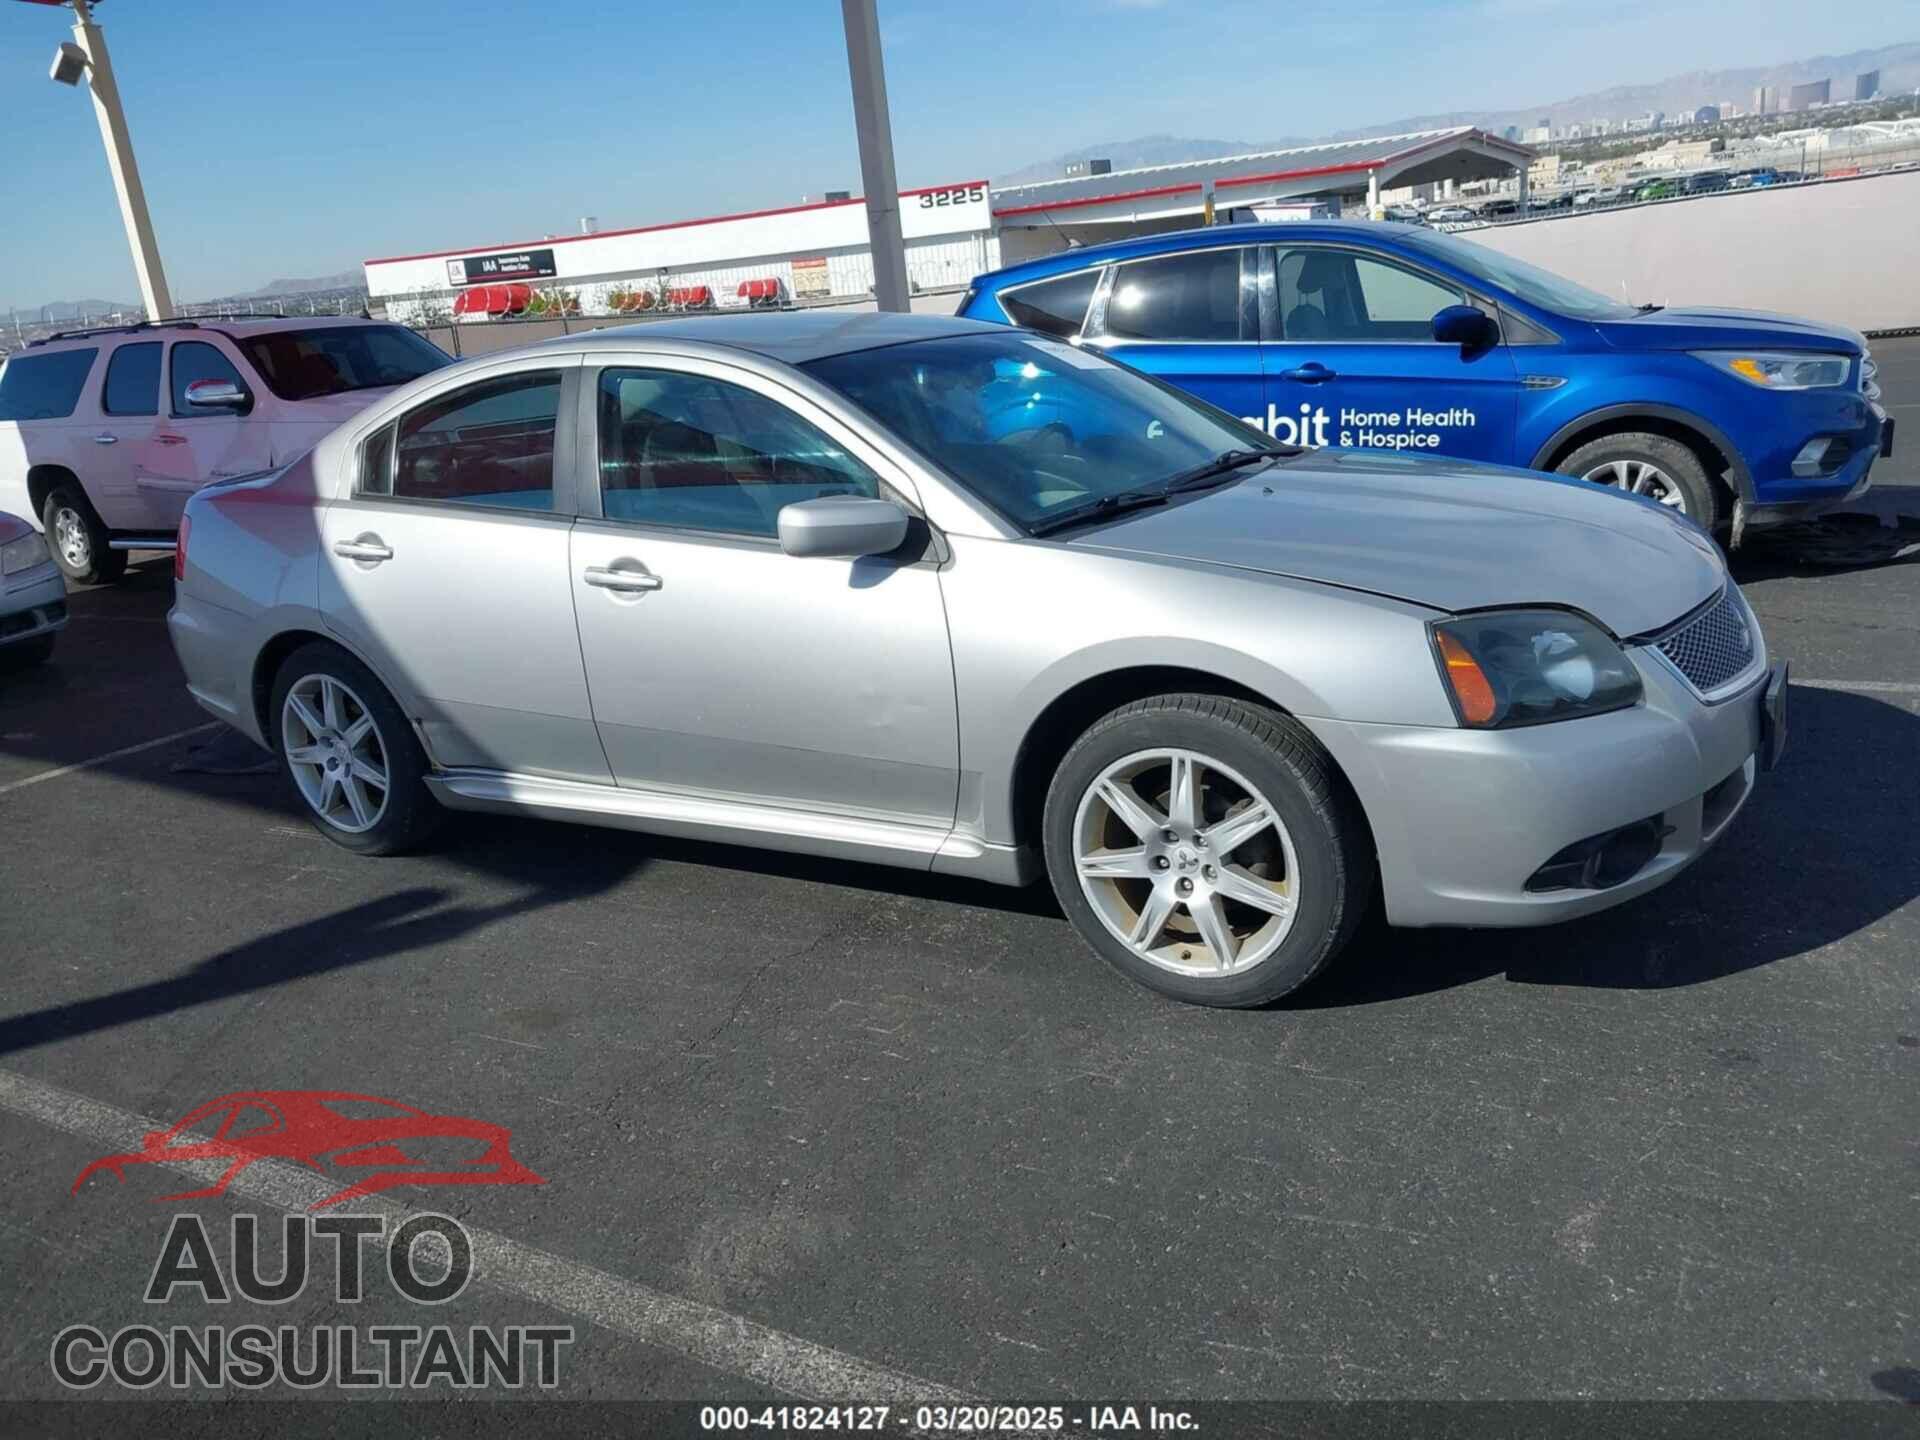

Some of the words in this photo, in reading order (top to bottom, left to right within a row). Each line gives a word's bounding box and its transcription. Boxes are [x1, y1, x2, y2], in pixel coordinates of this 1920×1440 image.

[919, 187, 984, 208] 3225
[482, 260, 497, 272] IAA
[1340, 408, 1401, 426] Home
[1406, 408, 1475, 426] Health
[1340, 431, 1353, 447] &
[1359, 429, 1440, 450] Hospice
